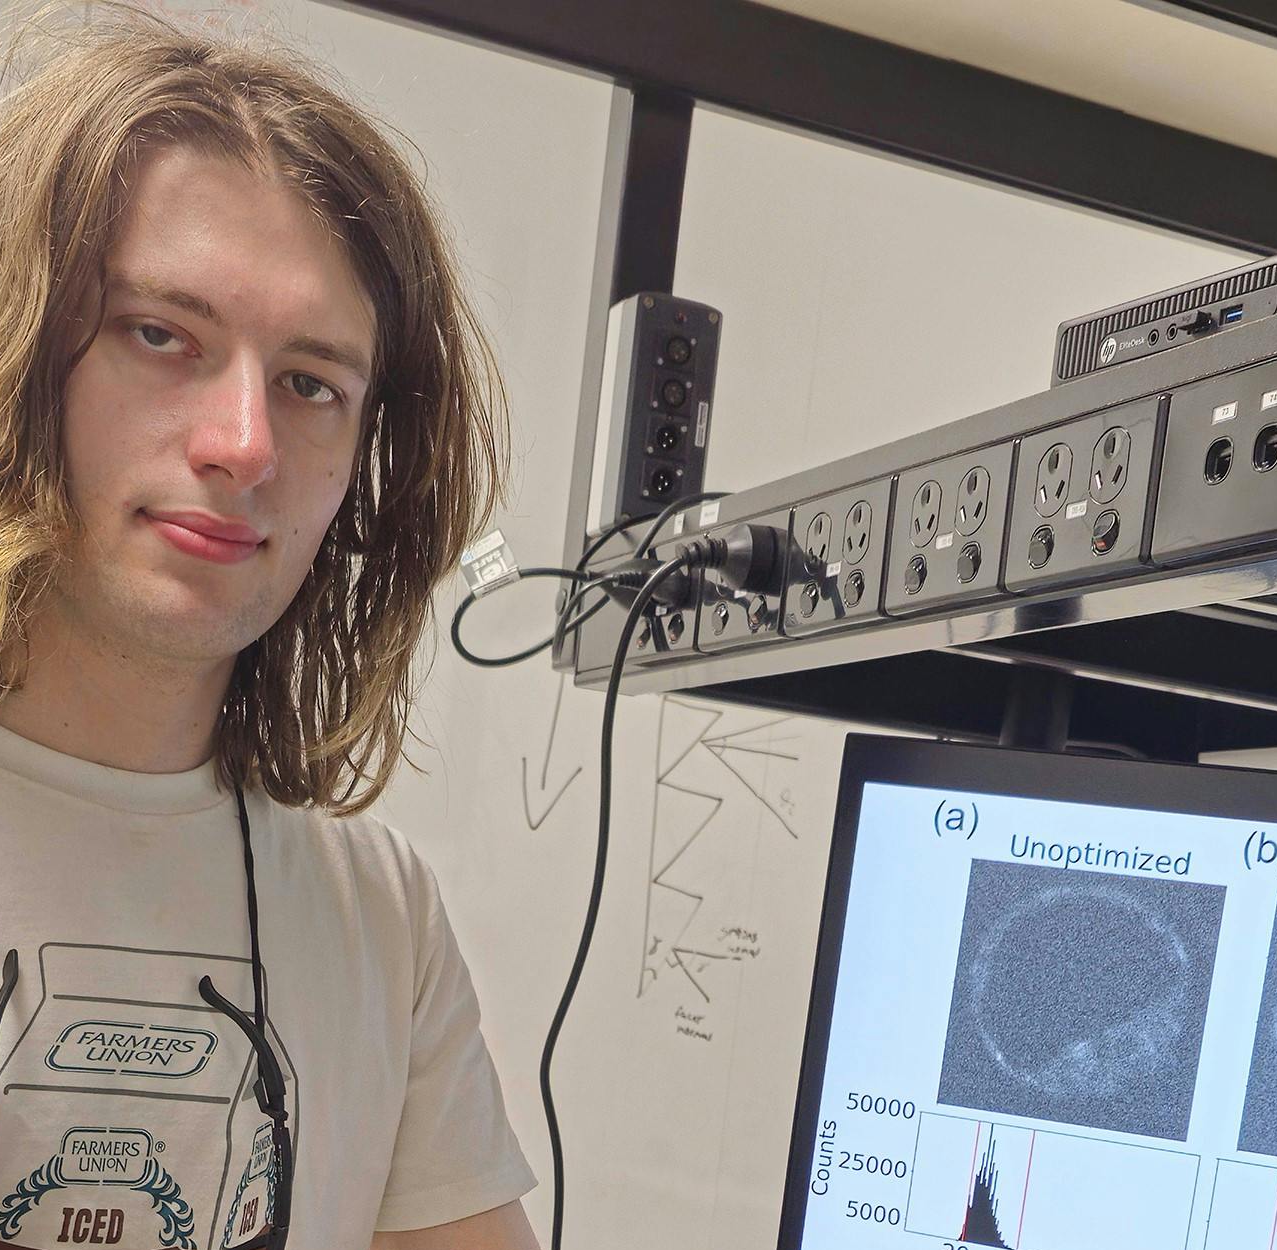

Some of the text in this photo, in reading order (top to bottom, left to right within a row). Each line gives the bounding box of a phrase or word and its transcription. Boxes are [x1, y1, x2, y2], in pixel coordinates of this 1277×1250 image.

[933, 799, 980, 840] (a)
[1010, 834, 1192, 876] Unoptimized
[77, 1029, 197, 1055] FARMERS
[85, 1044, 174, 1068] UNION
[846, 1093, 916, 1121] 50000
[70, 1139, 148, 1159] FARMERS
[811, 1120, 838, 1197] Counts
[77, 1154, 129, 1175] UNION
[839, 1152, 908, 1180] 25000
[57, 1206, 125, 1246] ICED
[846, 1201, 902, 1227] 5000
